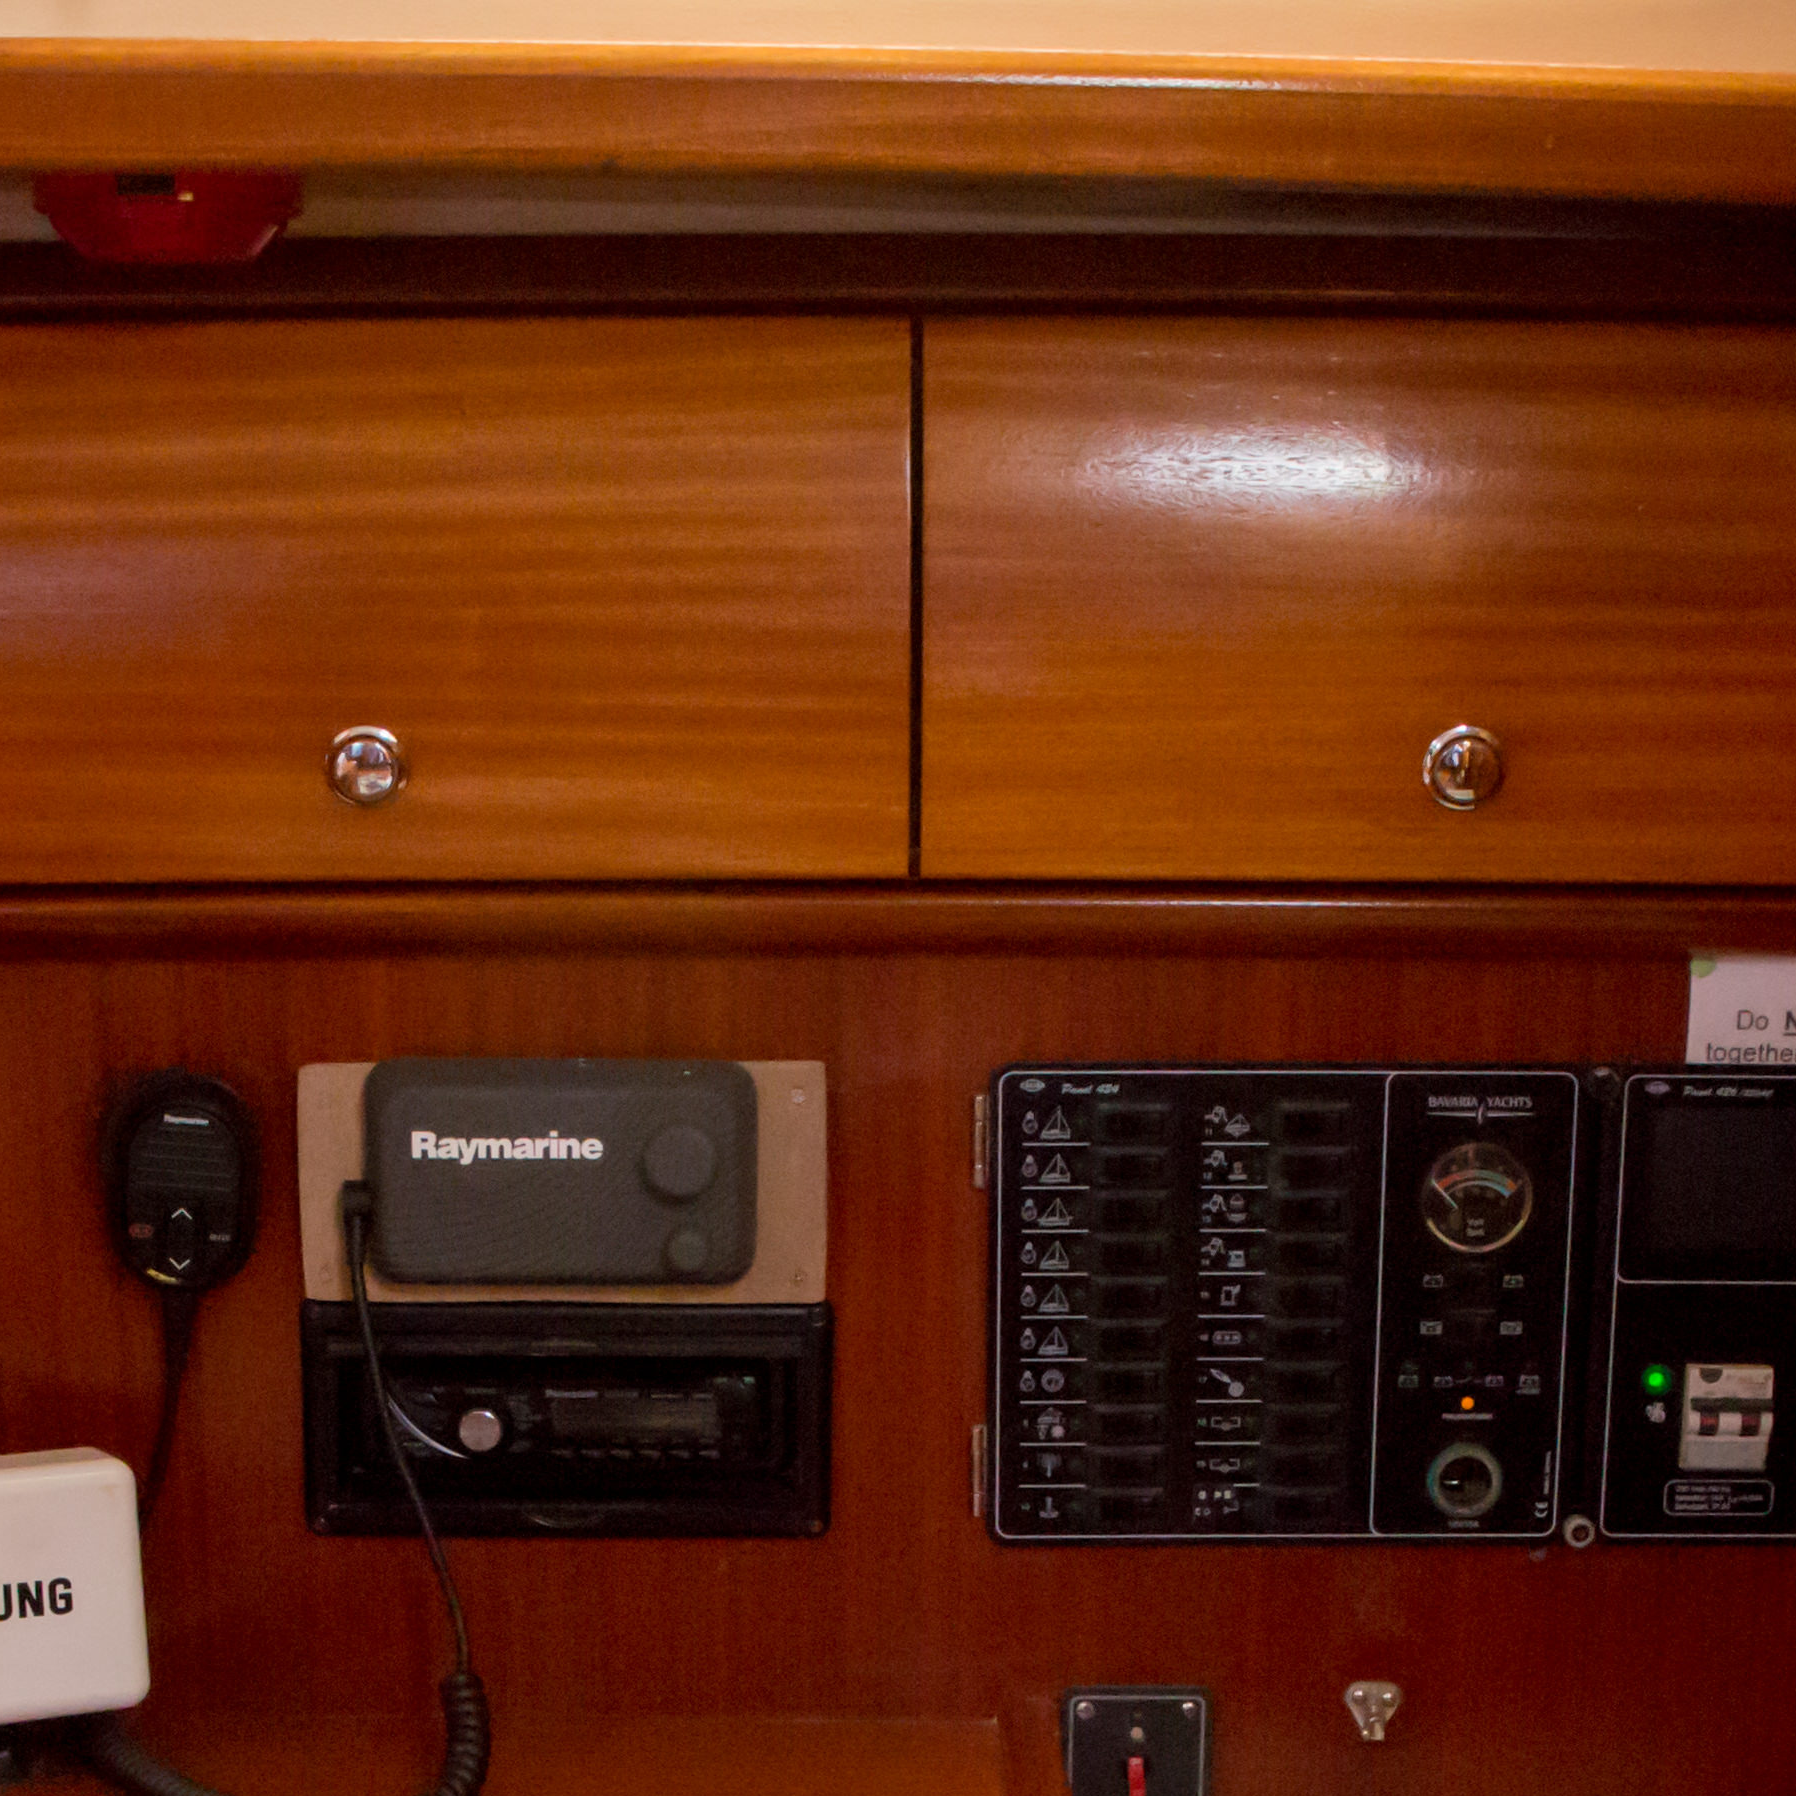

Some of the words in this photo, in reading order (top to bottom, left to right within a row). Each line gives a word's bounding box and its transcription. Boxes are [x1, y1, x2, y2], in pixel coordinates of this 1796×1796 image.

[1735, 1009, 1769, 1031] Do
[1428, 1096, 1478, 1108] BAVARIA
[1487, 1096, 1533, 1109] YACHTS
[411, 1130, 604, 1165] Raymarine
